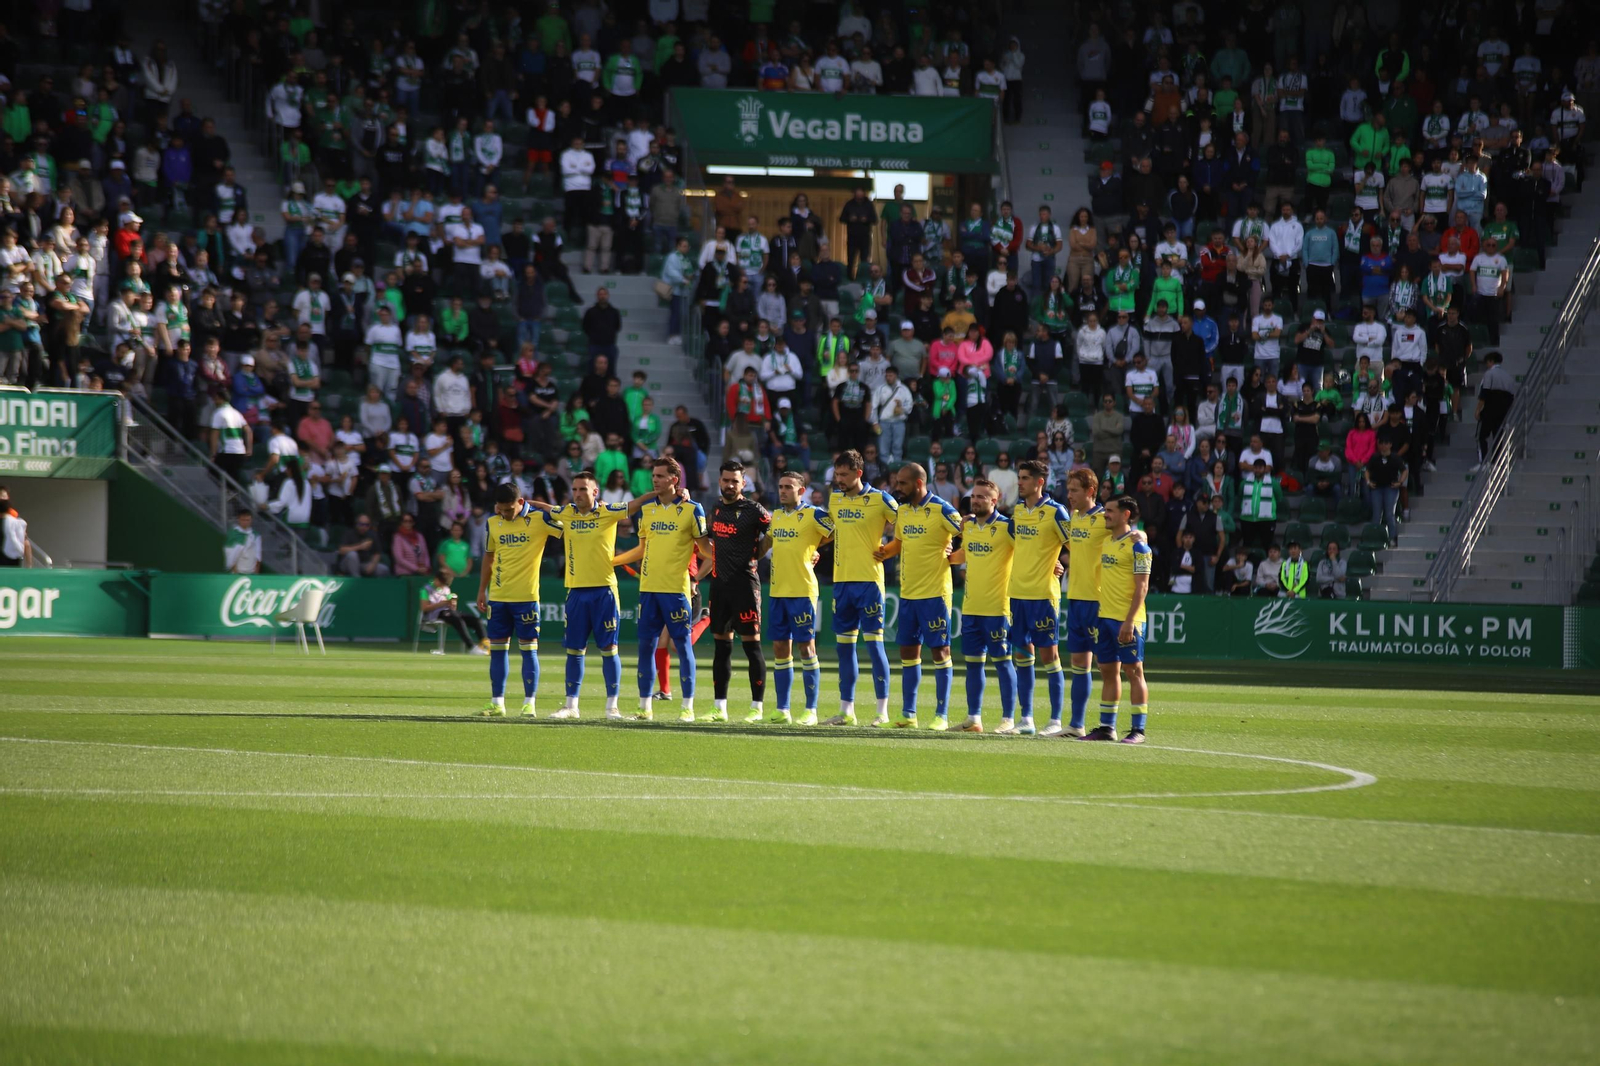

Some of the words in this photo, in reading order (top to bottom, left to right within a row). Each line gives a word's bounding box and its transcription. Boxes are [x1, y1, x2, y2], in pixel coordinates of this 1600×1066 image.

[806, 157, 843, 168] SALIDA
[851, 158, 873, 169] EXIT
[15, 430, 77, 457] Fima
[837, 509, 865, 519] Silbö:
[570, 520, 599, 530] Silbö:
[650, 522, 679, 531] Silbö:
[712, 521, 738, 535] Silbö:
[902, 525, 927, 535] Silbö:
[1016, 525, 1039, 536] Silbö:
[499, 533, 530, 545] Silbö:
[773, 528, 799, 538] Silbö:
[967, 542, 993, 552] Silbö:
[0, 586, 60, 629] gar
[220, 576, 344, 628] Coca-Cla
[670, 608, 689, 620] wh
[739, 609, 757, 620] wh
[794, 612, 812, 624] wh
[928, 617, 946, 628] wh
[1035, 616, 1055, 629] wh
[1329, 612, 1457, 638] KLINIK
[1481, 616, 1532, 640] PM
[1329, 640, 1460, 656] TRAUMATOLOGÍA
[1464, 644, 1475, 656] Y
[1479, 645, 1532, 658] DOLOR
